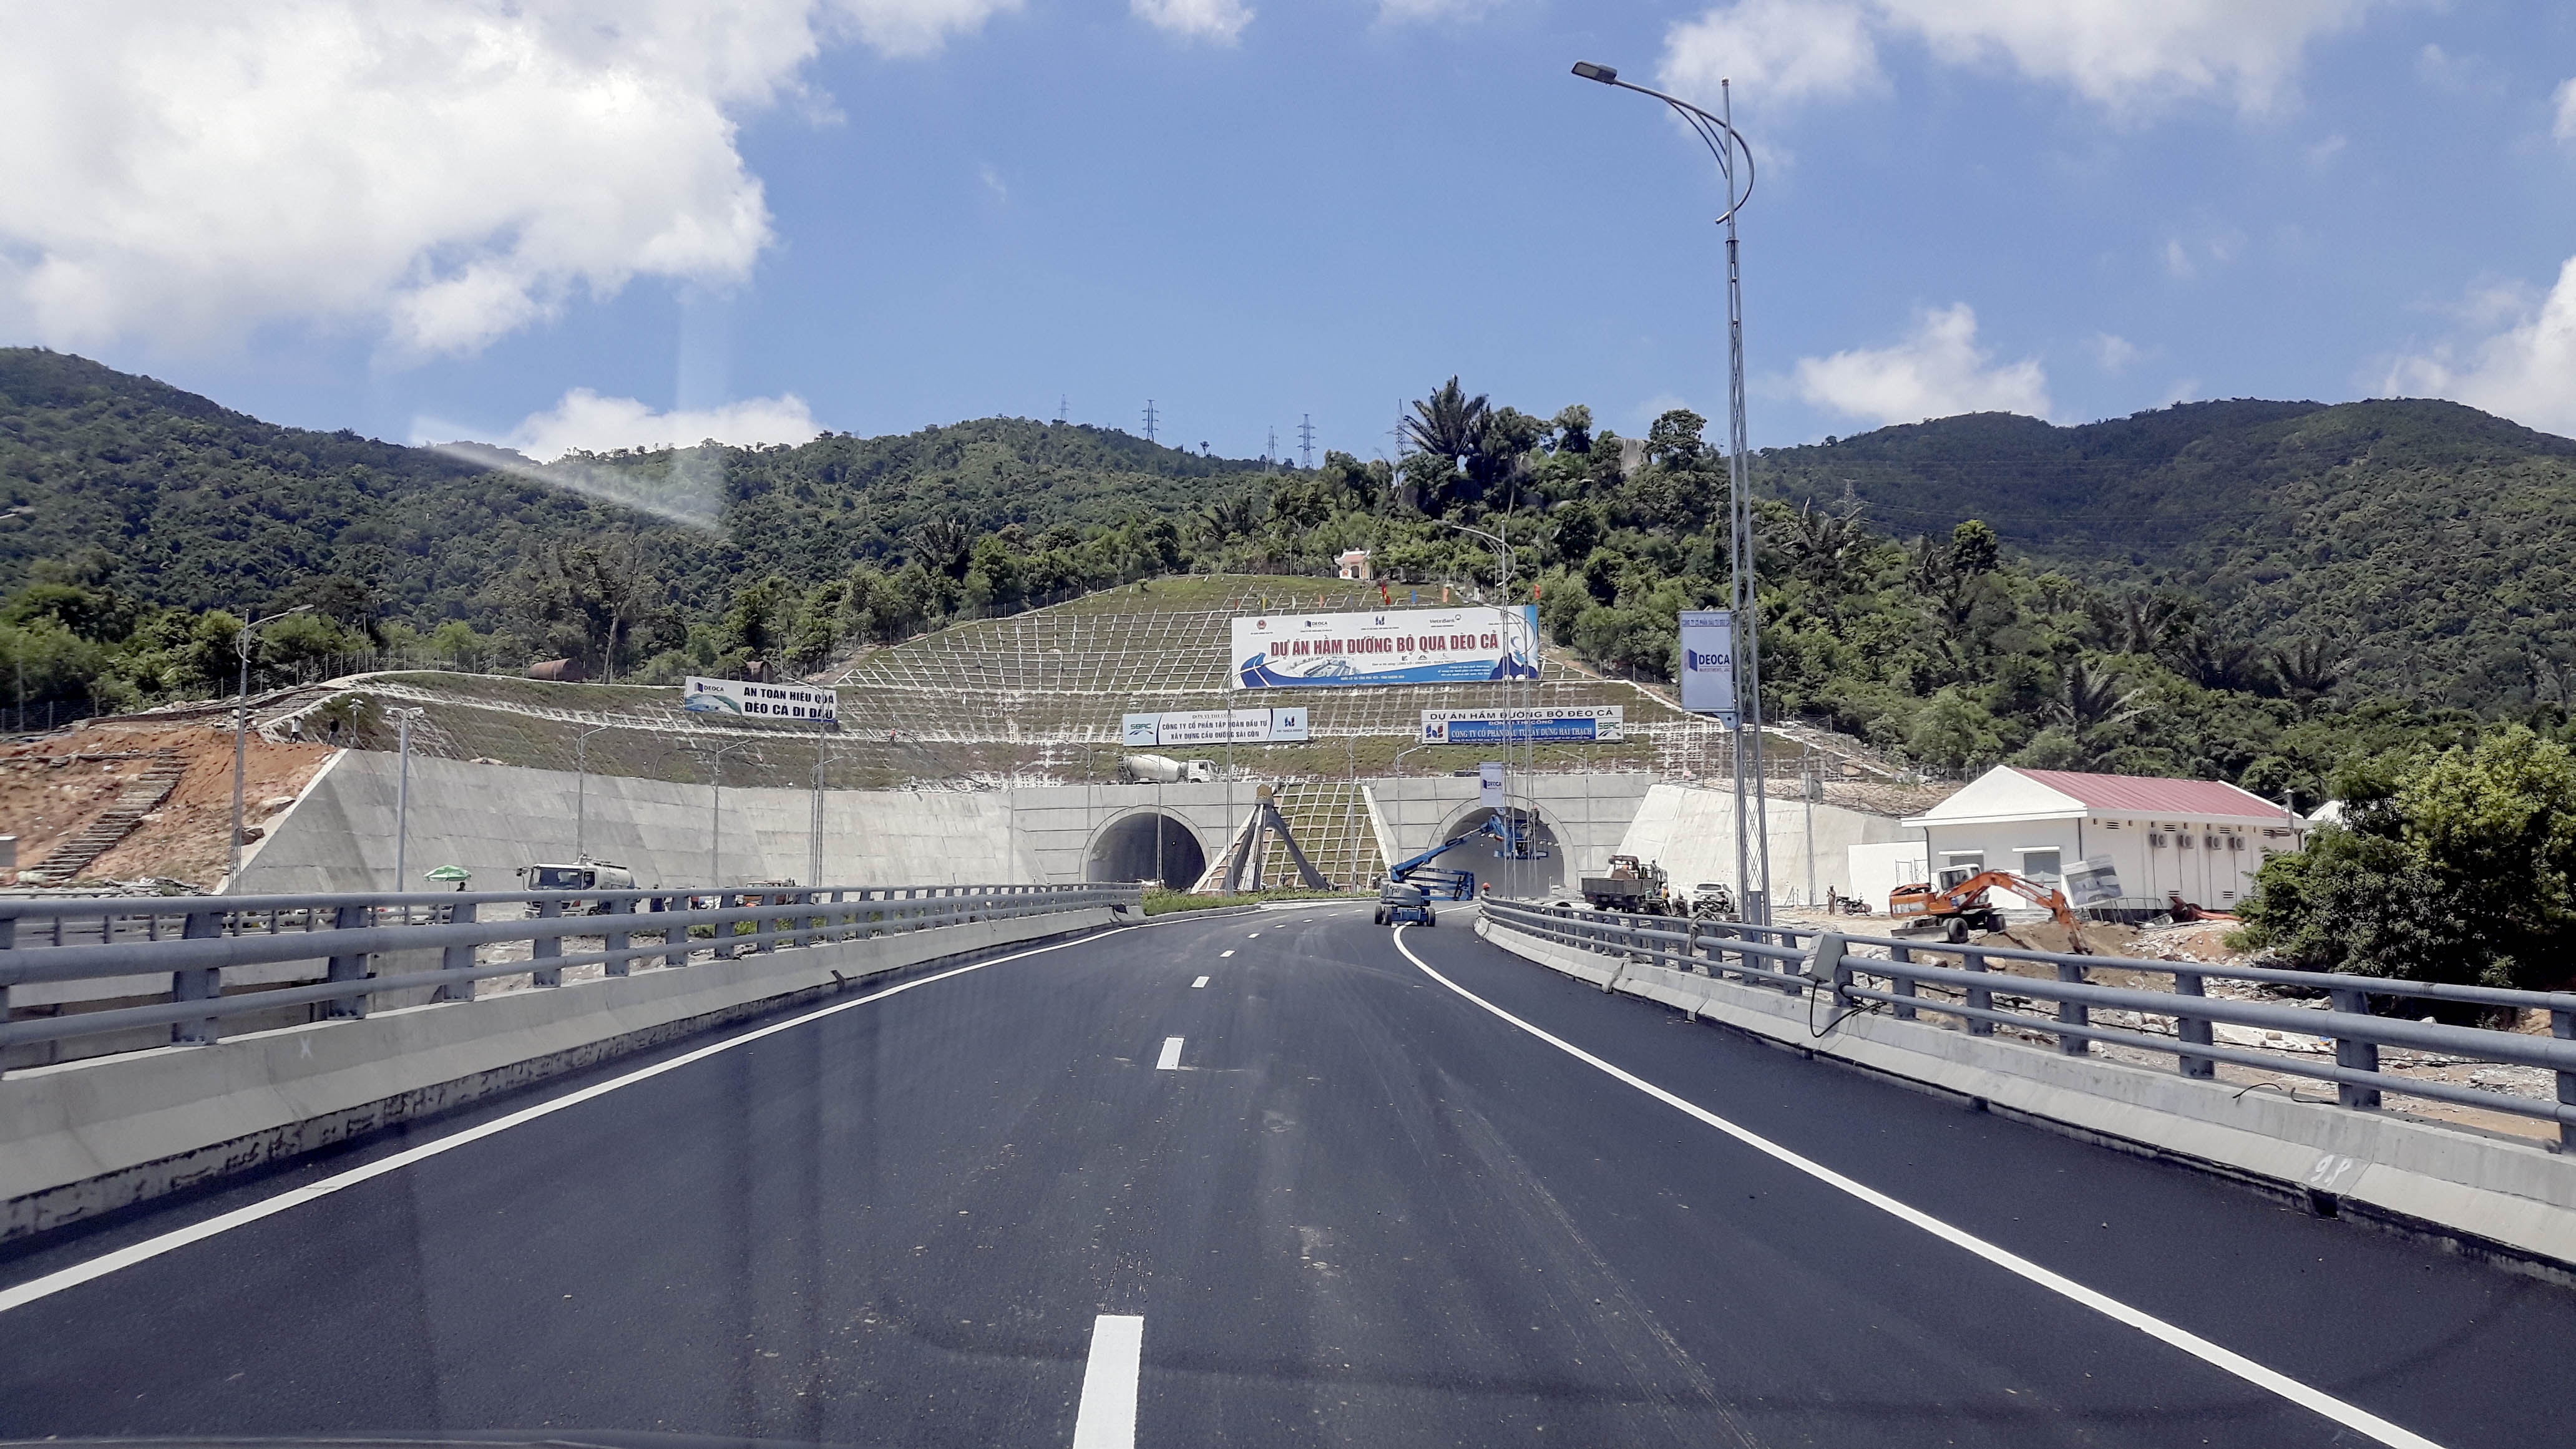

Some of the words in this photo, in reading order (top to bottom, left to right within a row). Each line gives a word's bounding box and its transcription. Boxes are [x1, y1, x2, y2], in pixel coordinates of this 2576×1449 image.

[1271, 639, 1290, 660] DỰ
[1292, 638, 1310, 656] ÁN
[1314, 635, 1342, 655] HẦM
[1347, 636, 1392, 654] ĐƯỜNG
[1397, 634, 1415, 655] BỘ
[1419, 635, 1447, 653] QUA
[1450, 632, 1476, 650] ĐÈO
[1480, 630, 1498, 649] CẢ
[1699, 654, 1730, 665] DEOCA
[744, 687, 757, 697] AN
[761, 688, 786, 700] TOÀN
[789, 691, 811, 703] HIỆU
[744, 701, 768, 714] ĐÈO
[773, 703, 789, 716] CẢ
[793, 706, 805, 717] ĐI
[1450, 711, 1466, 720] ÁN
[1547, 710, 1563, 718] BỘ
[1597, 708, 1613, 716] CẢ
[1451, 728, 1468, 738] CÔNG
[1469, 729, 1476, 738] TY
[1572, 728, 1592, 736] THẠCH
